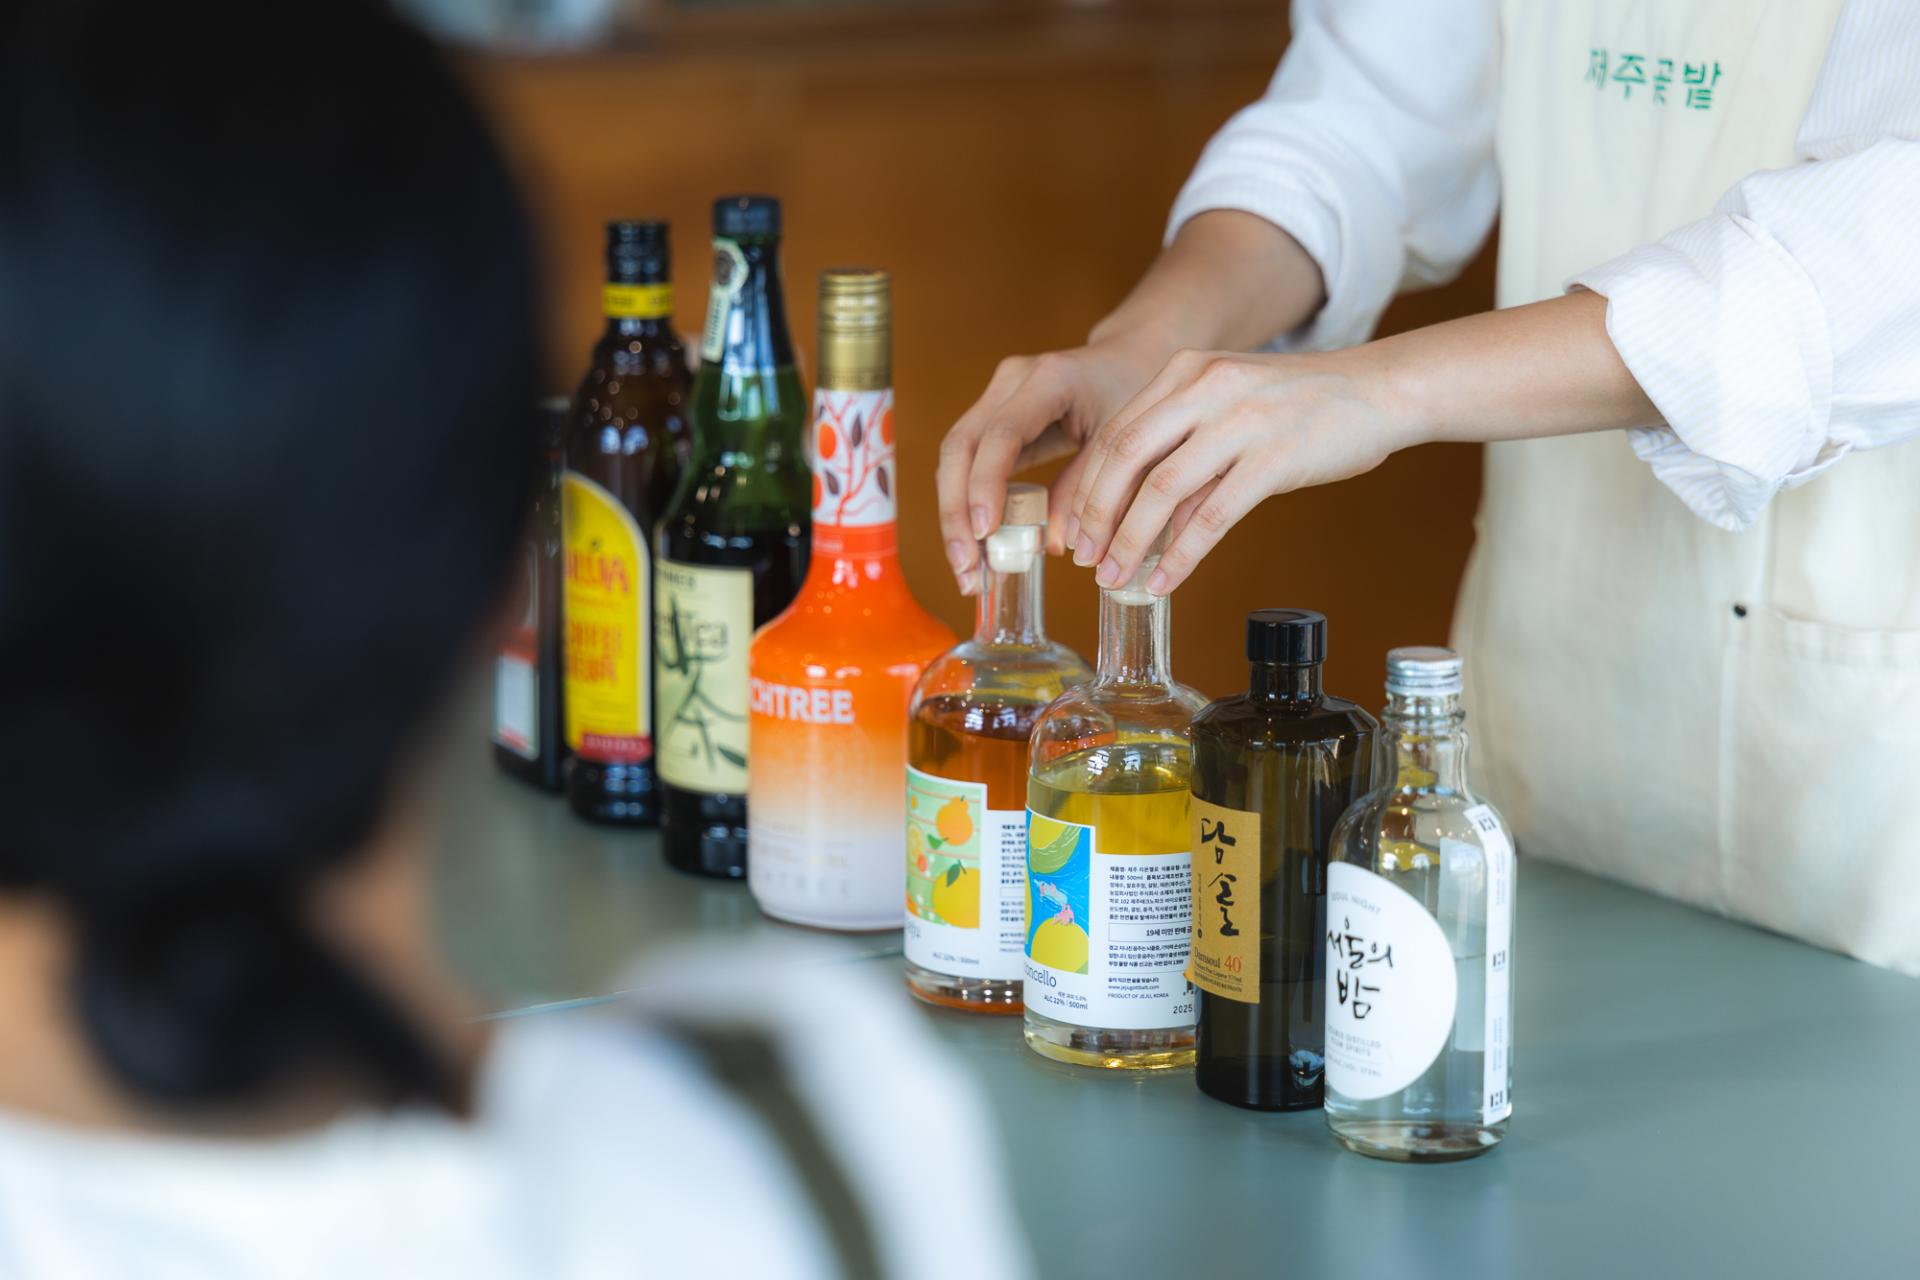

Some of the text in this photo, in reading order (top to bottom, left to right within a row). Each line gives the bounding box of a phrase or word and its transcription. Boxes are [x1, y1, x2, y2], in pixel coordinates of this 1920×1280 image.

[1161, 928, 1174, 936] 미만
[1174, 927, 1186, 935] 판매
[1023, 958, 1057, 988] oncello
[1069, 1000, 1088, 1010] 500ml
[1173, 1003, 1193, 1014] 2025
